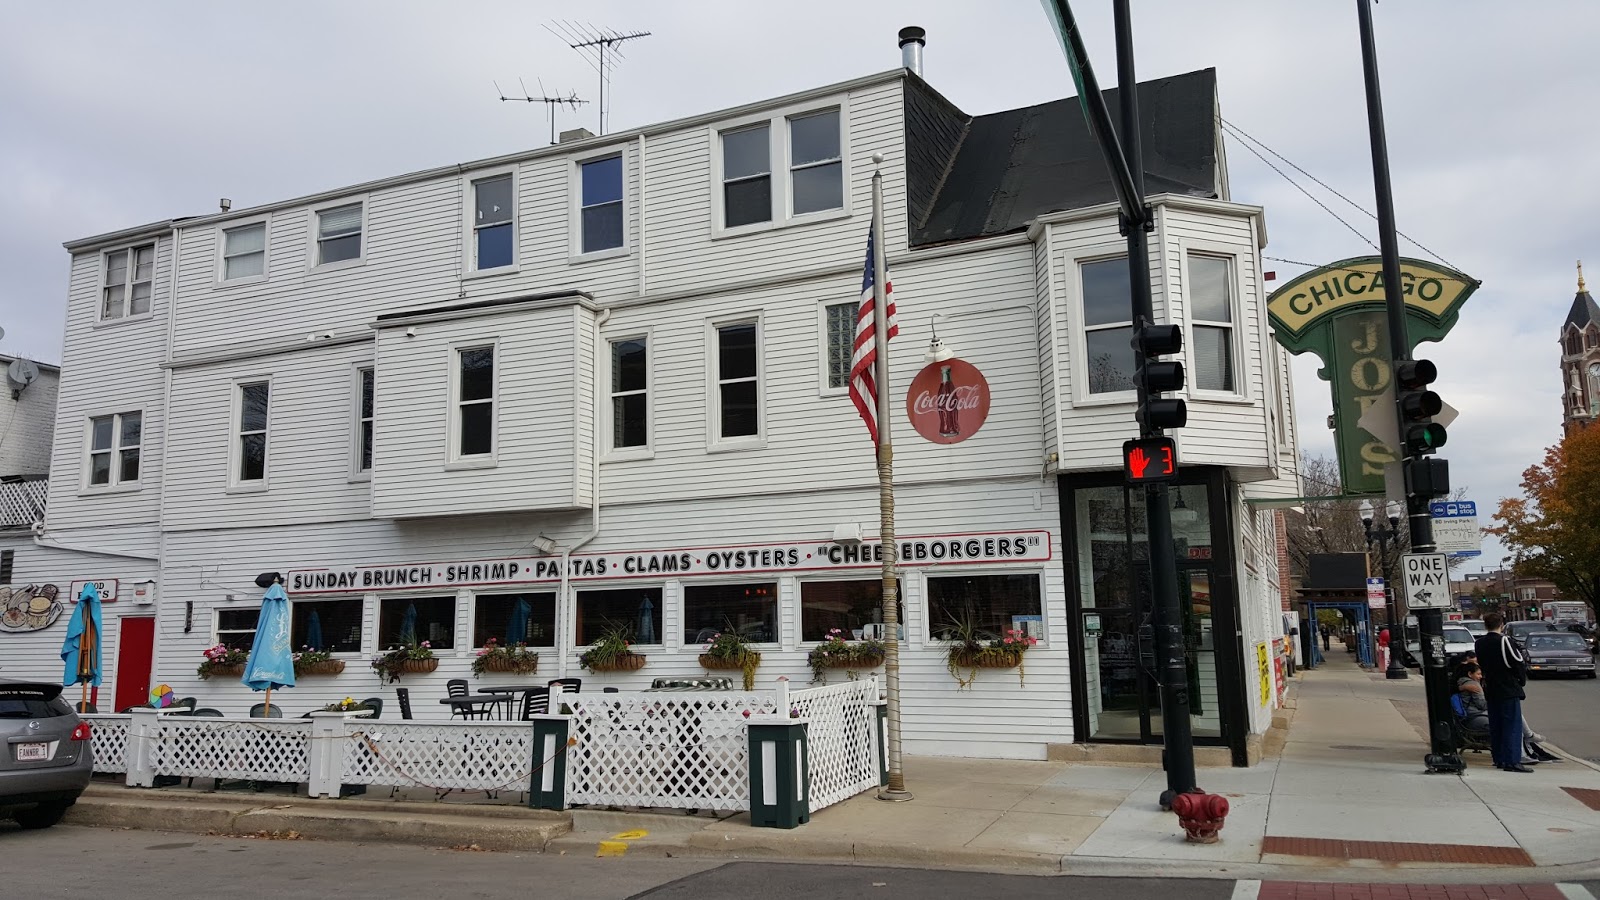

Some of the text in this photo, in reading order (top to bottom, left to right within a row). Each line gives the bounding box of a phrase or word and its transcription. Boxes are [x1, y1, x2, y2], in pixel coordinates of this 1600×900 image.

[1289, 271, 1443, 315] CHICAGO
[1160, 446, 1173, 474] 3
[293, 571, 358, 590] SUNDAY
[363, 567, 432, 586] BRUNCH
[446, 562, 519, 581] SHRIMP
[623, 553, 691, 573] CLAMS
[705, 548, 800, 569] OYSTERS
[817, 536, 1040, 564] "CHEEEBORGERS"
[1408, 558, 1442, 571] ONE
[1409, 573, 1444, 586] WAY
